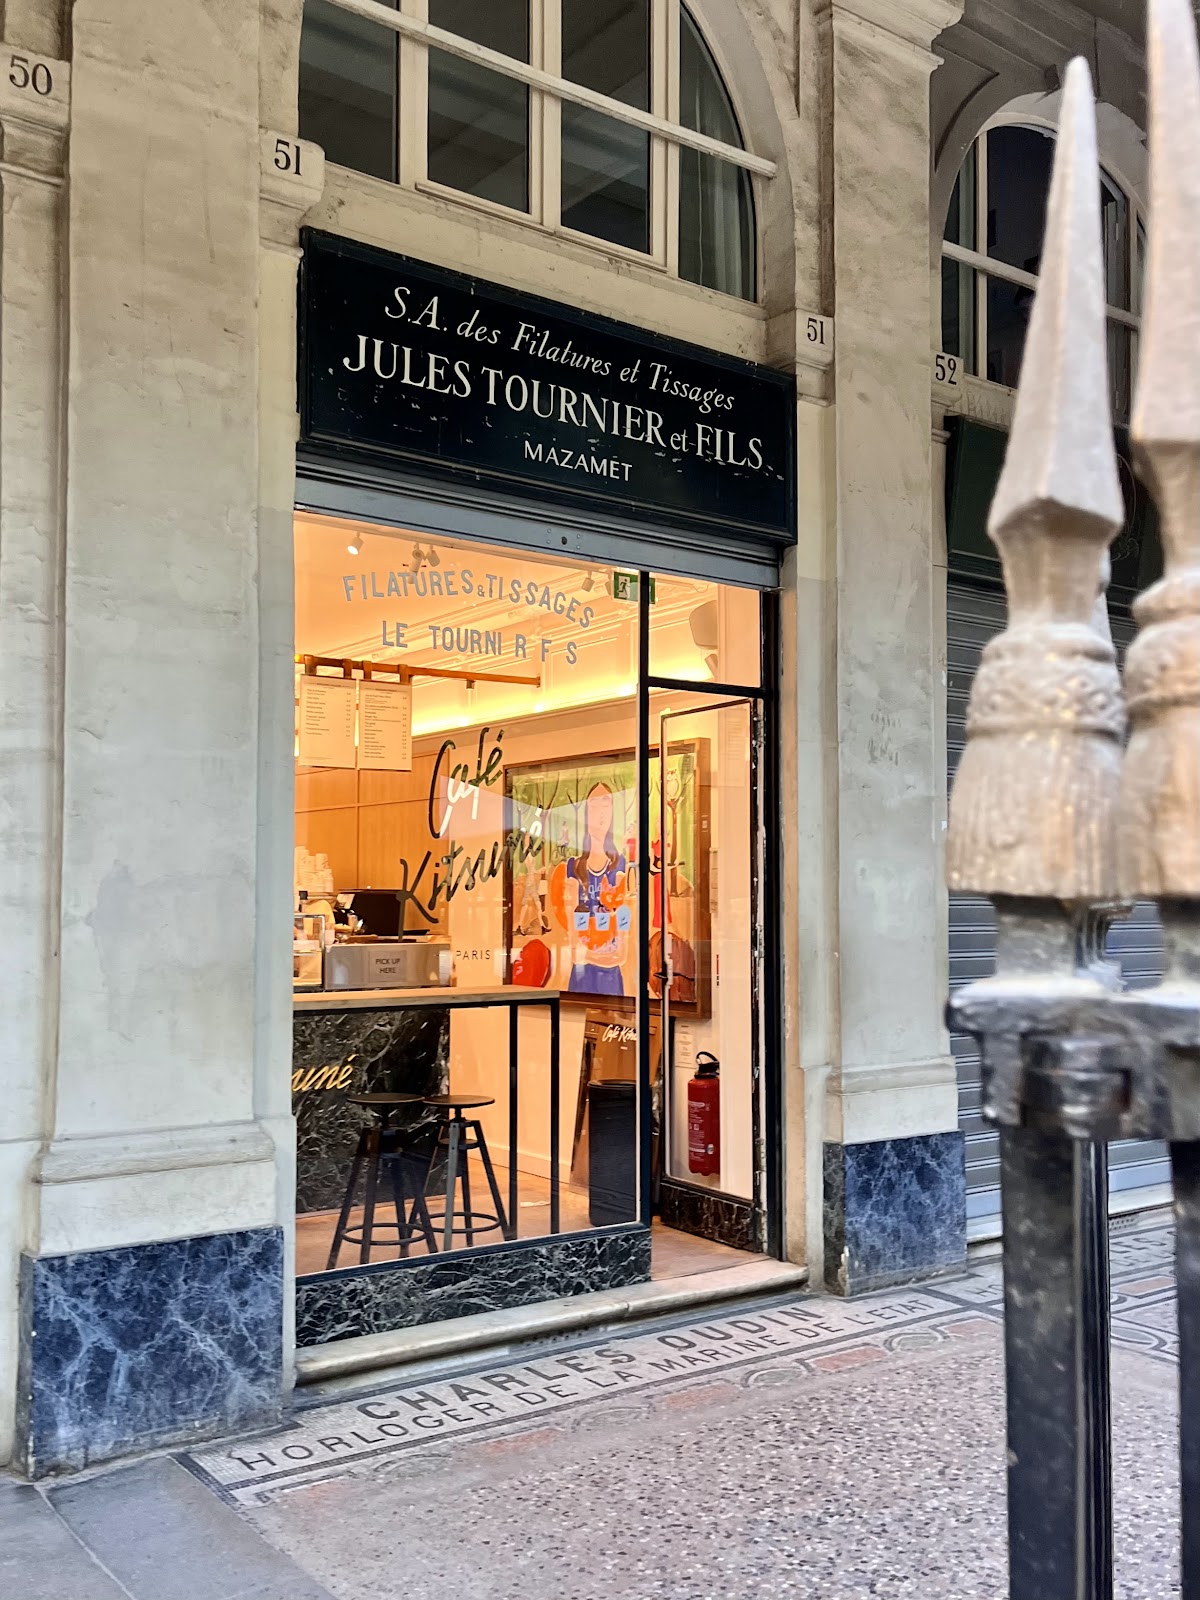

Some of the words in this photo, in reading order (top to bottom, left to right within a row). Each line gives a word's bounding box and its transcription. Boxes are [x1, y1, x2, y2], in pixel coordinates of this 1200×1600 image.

[8, 55, 53, 96] 50
[273, 138, 303, 176] 51
[384, 286, 449, 332] S.A.
[456, 309, 501, 345] des
[510, 321, 612, 376] Filatures
[619, 359, 642, 384] et
[649, 362, 735, 414] Tissages
[807, 317, 825, 345] 51
[935, 354, 957, 385] 52
[342, 334, 472, 398] JULES
[480, 365, 667, 448] TOURNIER
[670, 429, 689, 452] et
[695, 422, 763, 470] FILS
[523, 440, 633, 482] MAZAMET
[342, 569, 474, 602] FILATURES
[485, 573, 594, 628] TISSAGES
[382, 620, 408, 649] LE
[428, 727, 505, 839] Café
[396, 804, 545, 943] Kitsuné
[455, 949, 491, 961] PARIS
[291, 1053, 359, 1092] uné
[356, 1349, 636, 1420] CHARLES
[656, 1307, 824, 1351] OUDIN
[229, 1402, 506, 1471] HORLOGER
[513, 1384, 579, 1406] DE
[583, 1370, 643, 1388] LA
[647, 1334, 790, 1372] MARINE
[789, 1322, 844, 1338] DE
